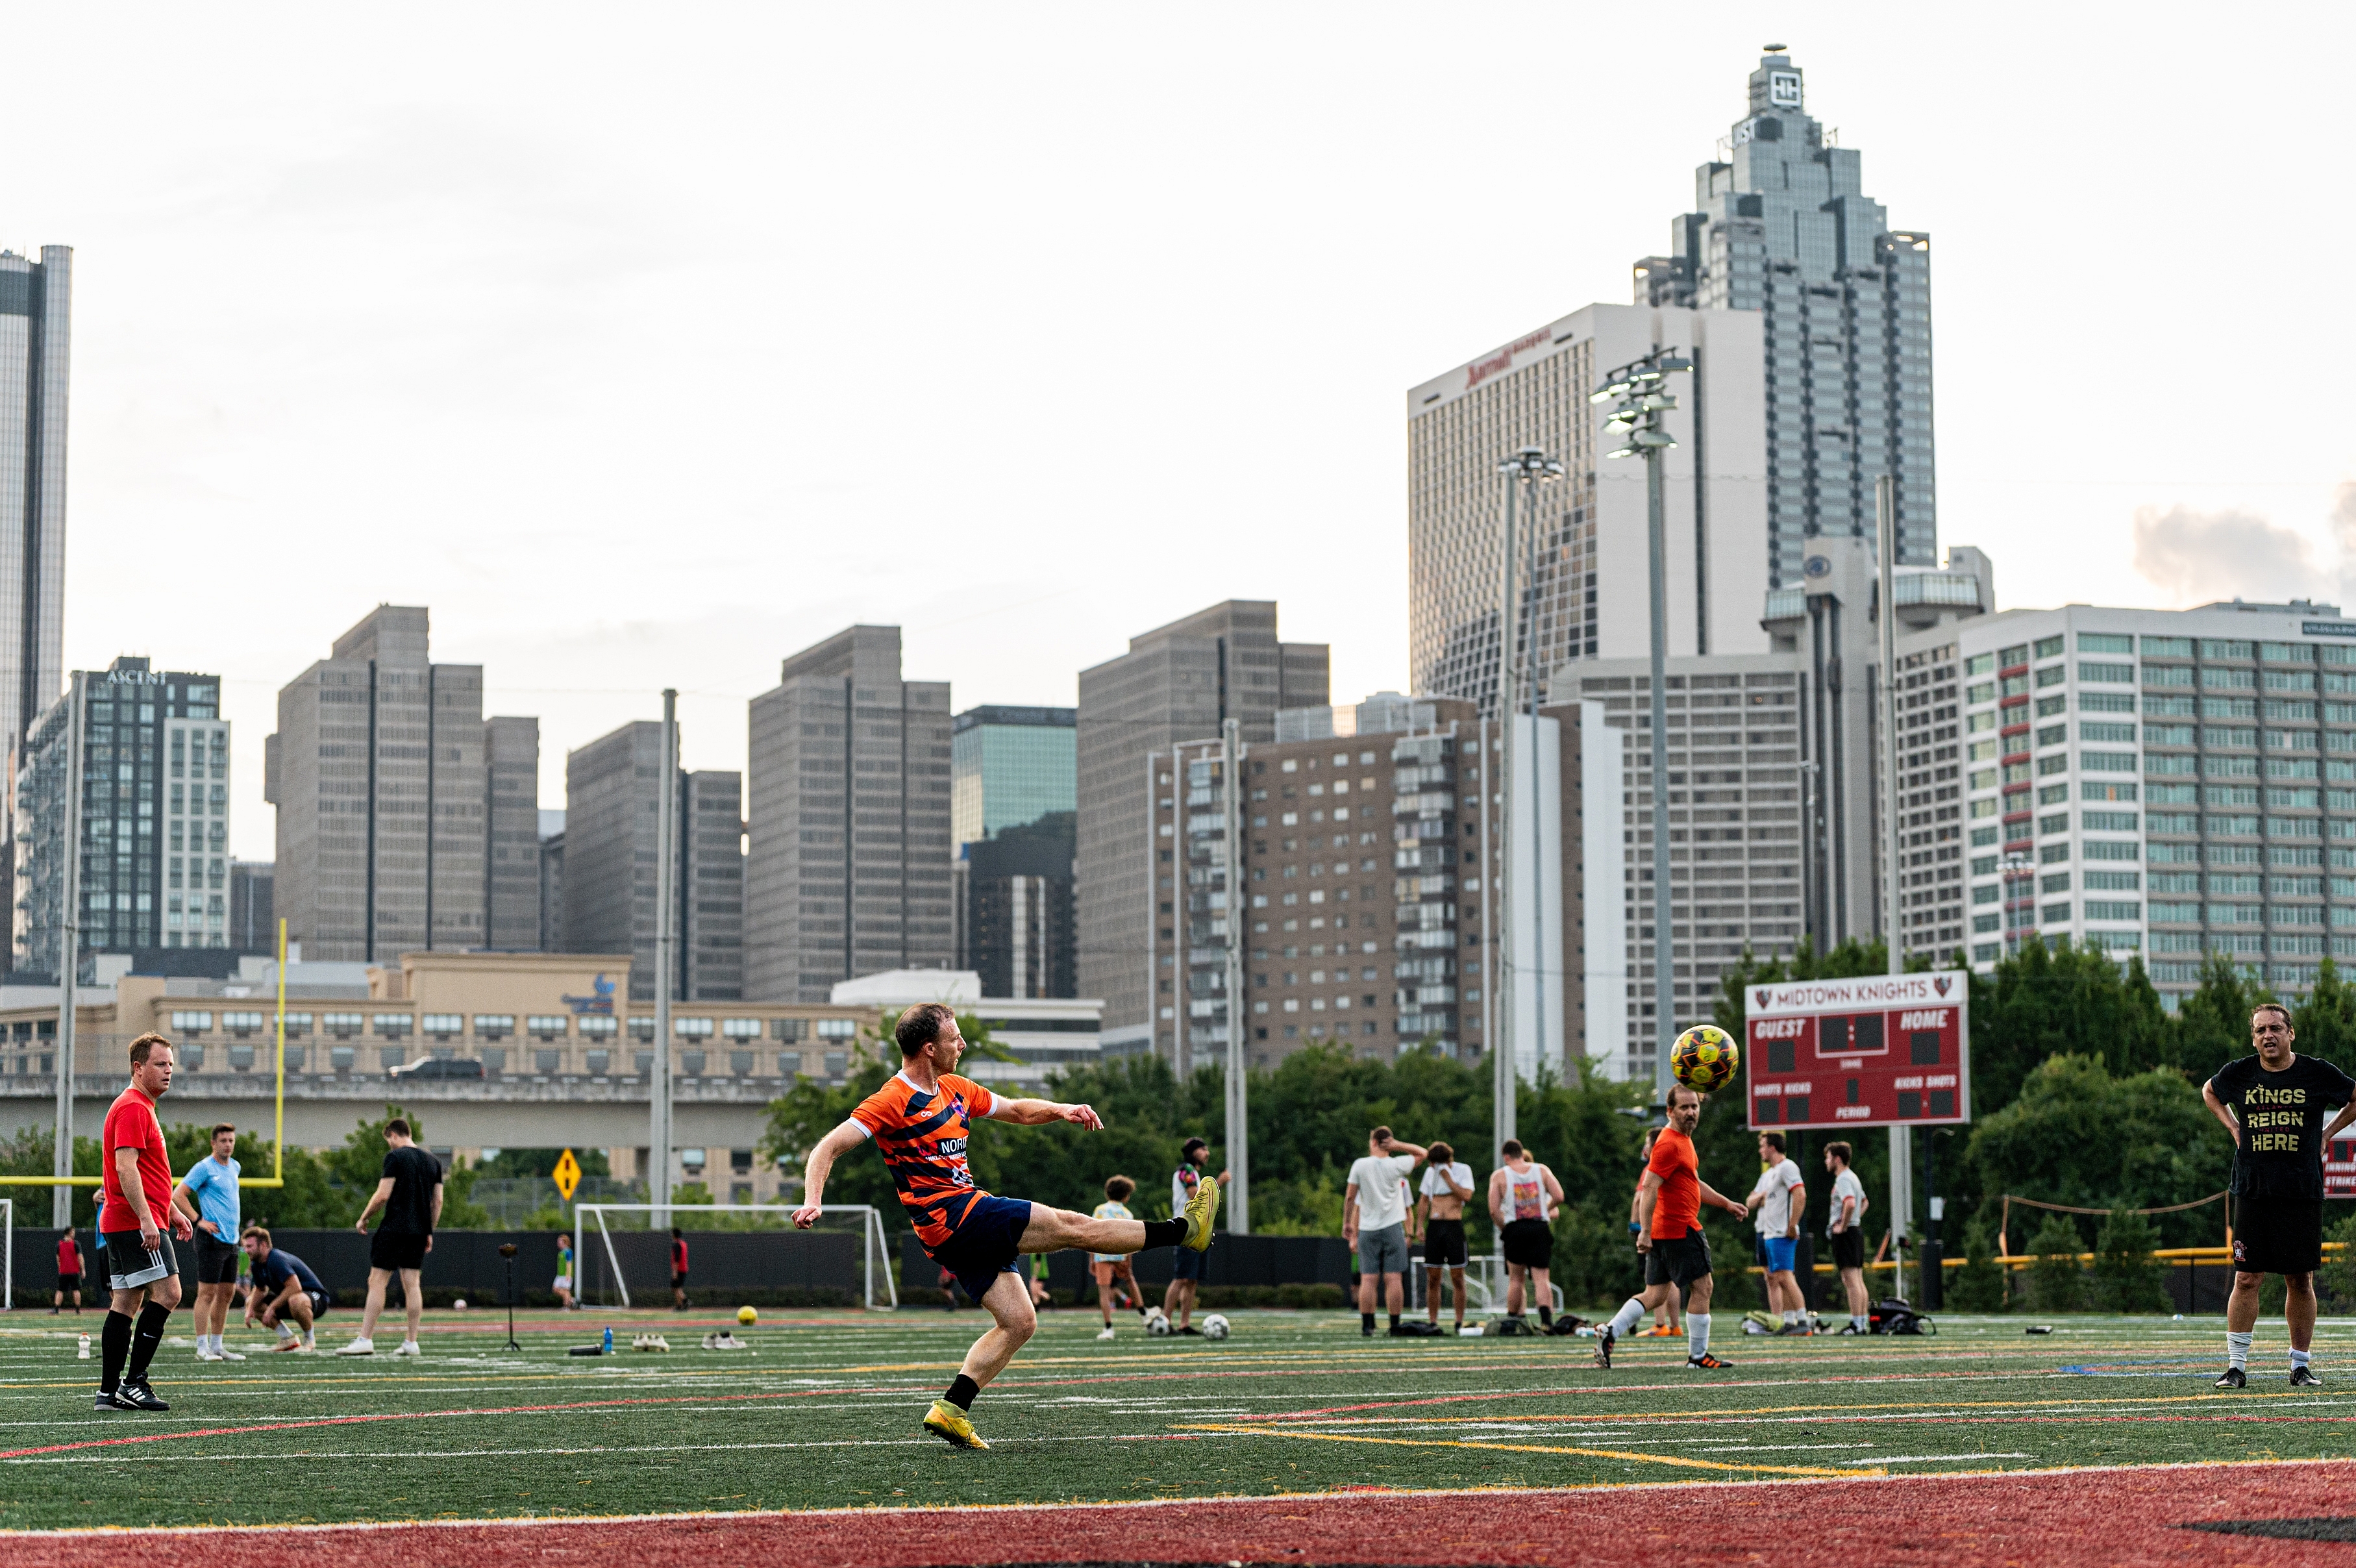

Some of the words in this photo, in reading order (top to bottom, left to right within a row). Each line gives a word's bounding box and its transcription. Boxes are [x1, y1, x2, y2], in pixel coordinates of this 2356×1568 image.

[1777, 986, 1850, 1006] MIDTOWN
[1857, 980, 1927, 1001] KNIGHTS
[1755, 1018, 1807, 1039] GUEST
[1900, 1009, 1950, 1030] HOME
[2245, 1087, 2306, 1104] KINGS
[1835, 1106, 1871, 1119] PERIOD
[2248, 1112, 2304, 1128] REIGN
[2252, 1134, 2299, 1152] HERE
